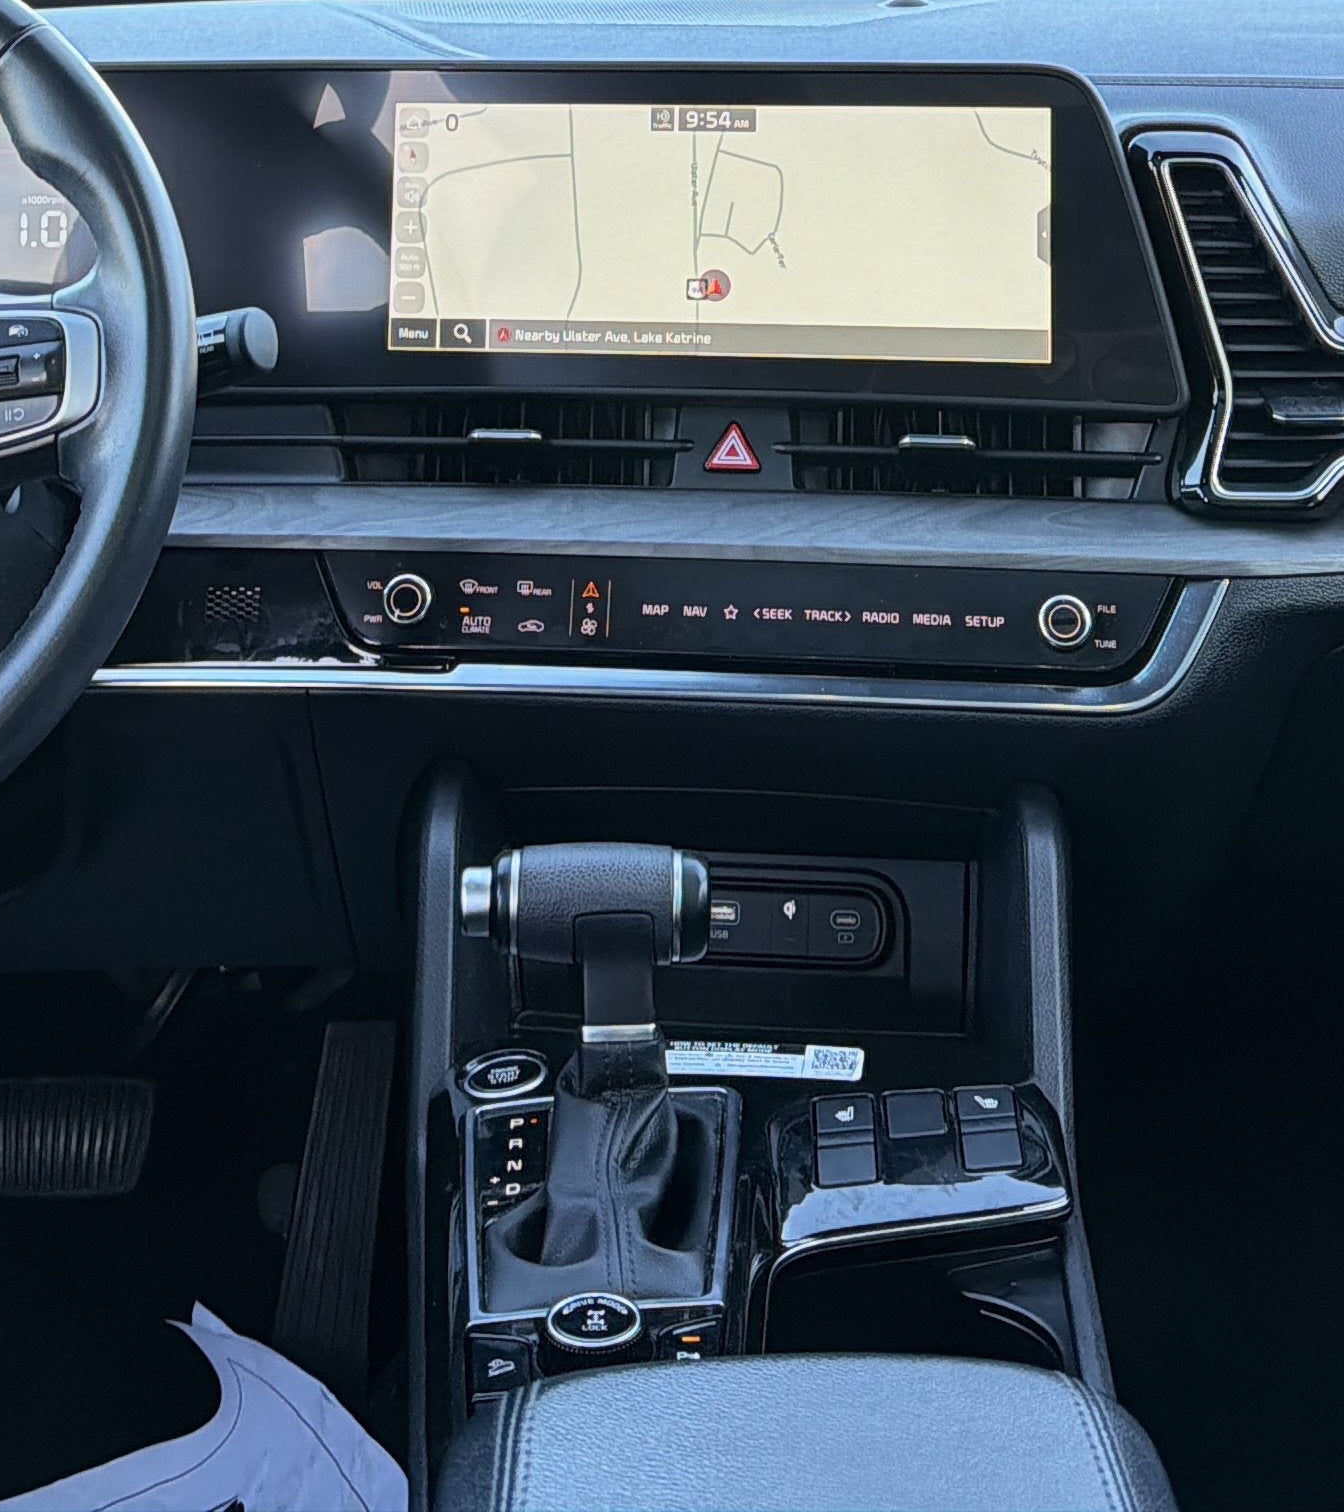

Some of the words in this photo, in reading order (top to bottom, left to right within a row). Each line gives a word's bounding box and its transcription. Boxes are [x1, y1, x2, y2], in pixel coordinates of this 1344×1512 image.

[685, 111, 731, 128] 9:54
[734, 120, 750, 128] AM
[20, 210, 68, 248] 1.0
[399, 328, 429, 339] Menu
[515, 329, 560, 343] Nearby
[562, 329, 602, 342] Ulster
[604, 331, 631, 344] Ave,
[634, 332, 663, 343] Lake
[666, 332, 712, 344] Katrine
[367, 581, 384, 590] VOL
[476, 586, 499, 594] FRONT
[533, 588, 552, 596] REAR
[642, 604, 670, 615] MAP
[683, 606, 708, 617] NAV
[762, 608, 793, 619] SEEK
[1097, 604, 1117, 614] FILE
[363, 614, 383, 624] PWR
[462, 616, 491, 626] AUTO
[804, 610, 842, 622] TRACK
[862, 612, 900, 624] RADIO
[912, 614, 952, 626] MEDIA
[965, 616, 1005, 628] SETUP
[461, 625, 490, 634] CLIMATE
[1094, 639, 1117, 649] TUNE
[710, 929, 729, 940] USB
[509, 1117, 525, 1131] P
[506, 1159, 523, 1173] N
[505, 1182, 521, 1196] D
[581, 1324, 609, 1332] LOCK
